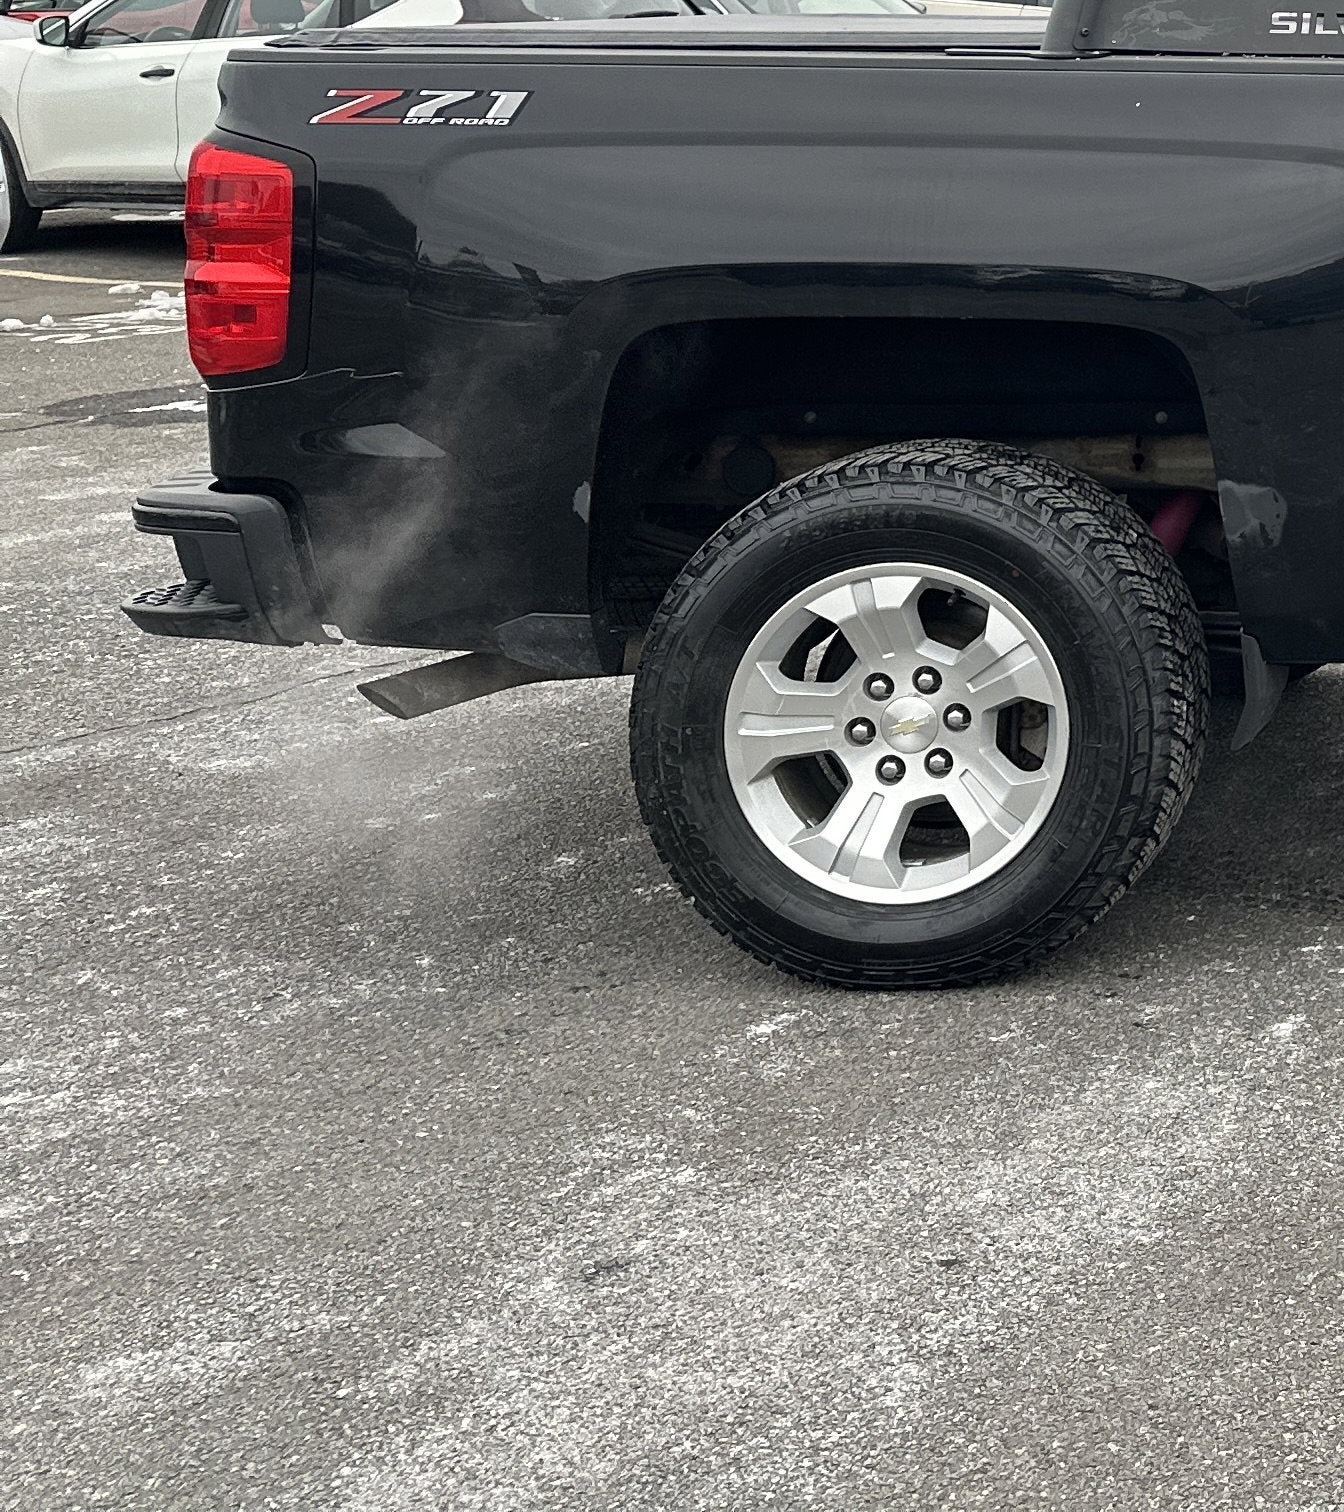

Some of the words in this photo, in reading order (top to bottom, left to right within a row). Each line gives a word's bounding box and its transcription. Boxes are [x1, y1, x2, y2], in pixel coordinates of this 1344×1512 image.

[308, 88, 532, 124] Z71
[402, 117, 446, 126] OFF
[449, 118, 511, 127] ROAD
